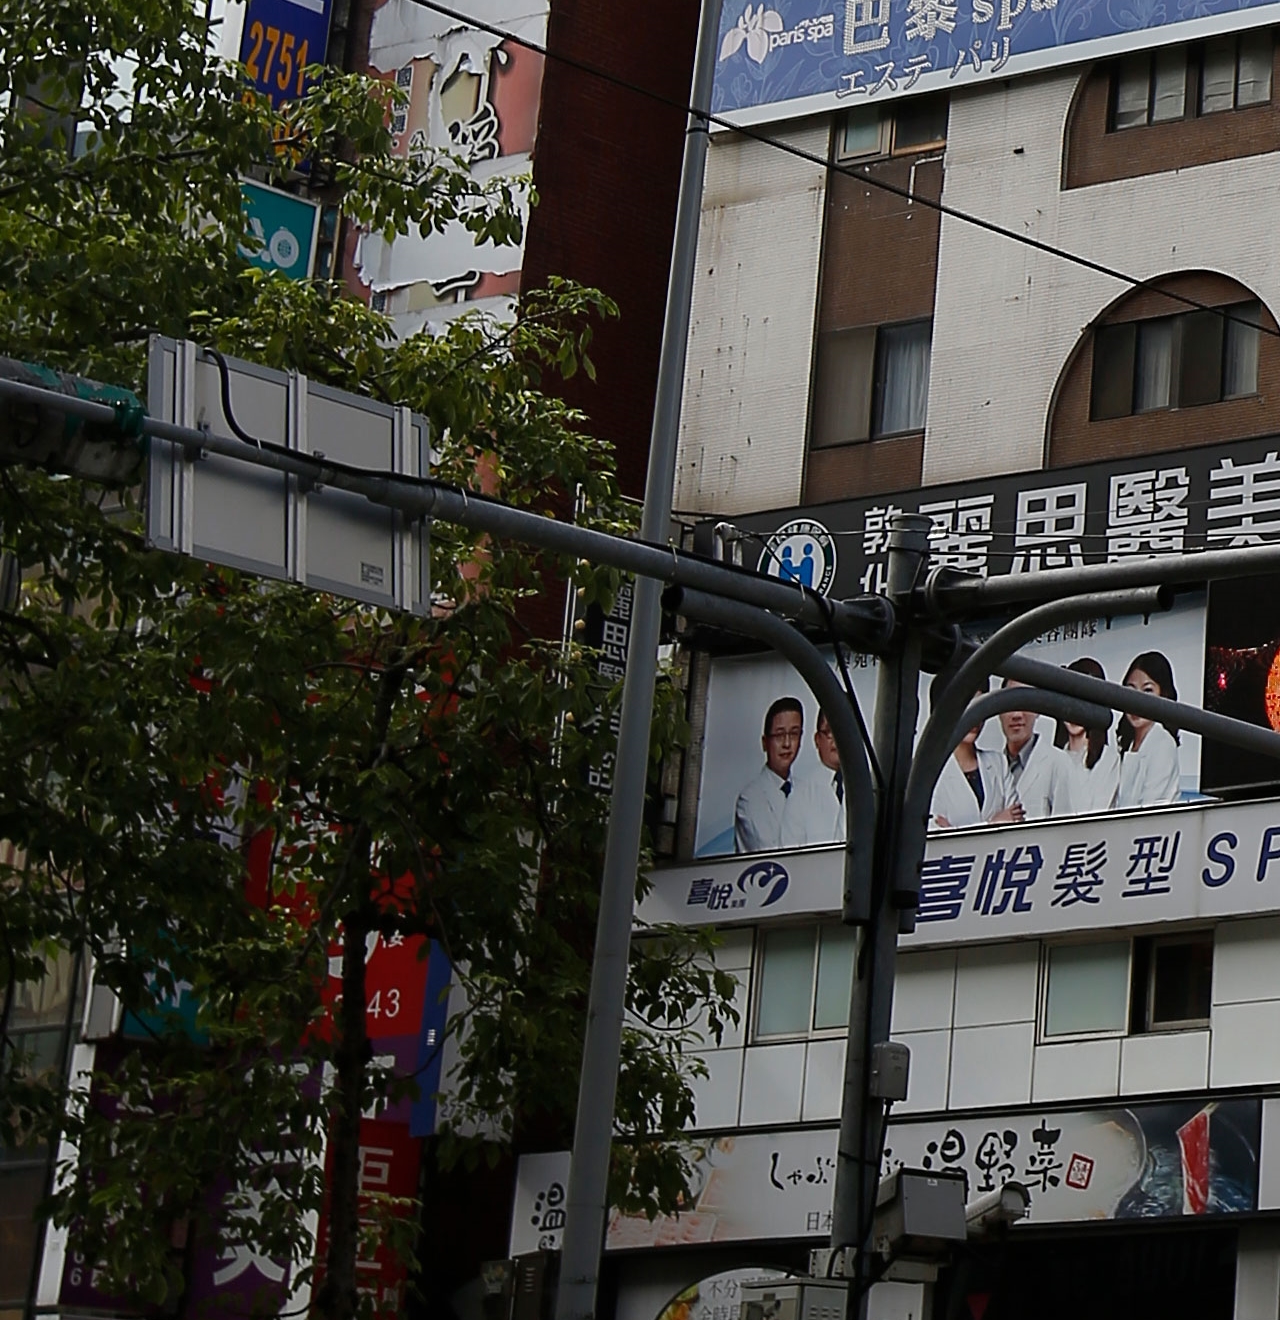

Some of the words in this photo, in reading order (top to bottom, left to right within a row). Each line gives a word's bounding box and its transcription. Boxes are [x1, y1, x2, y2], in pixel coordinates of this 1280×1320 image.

[245, 20, 309, 97] 2751
[768, 27, 805, 53] paris
[806, 21, 835, 43] spa
[835, 54, 932, 98] エステ
[950, 36, 1011, 79] パリ
